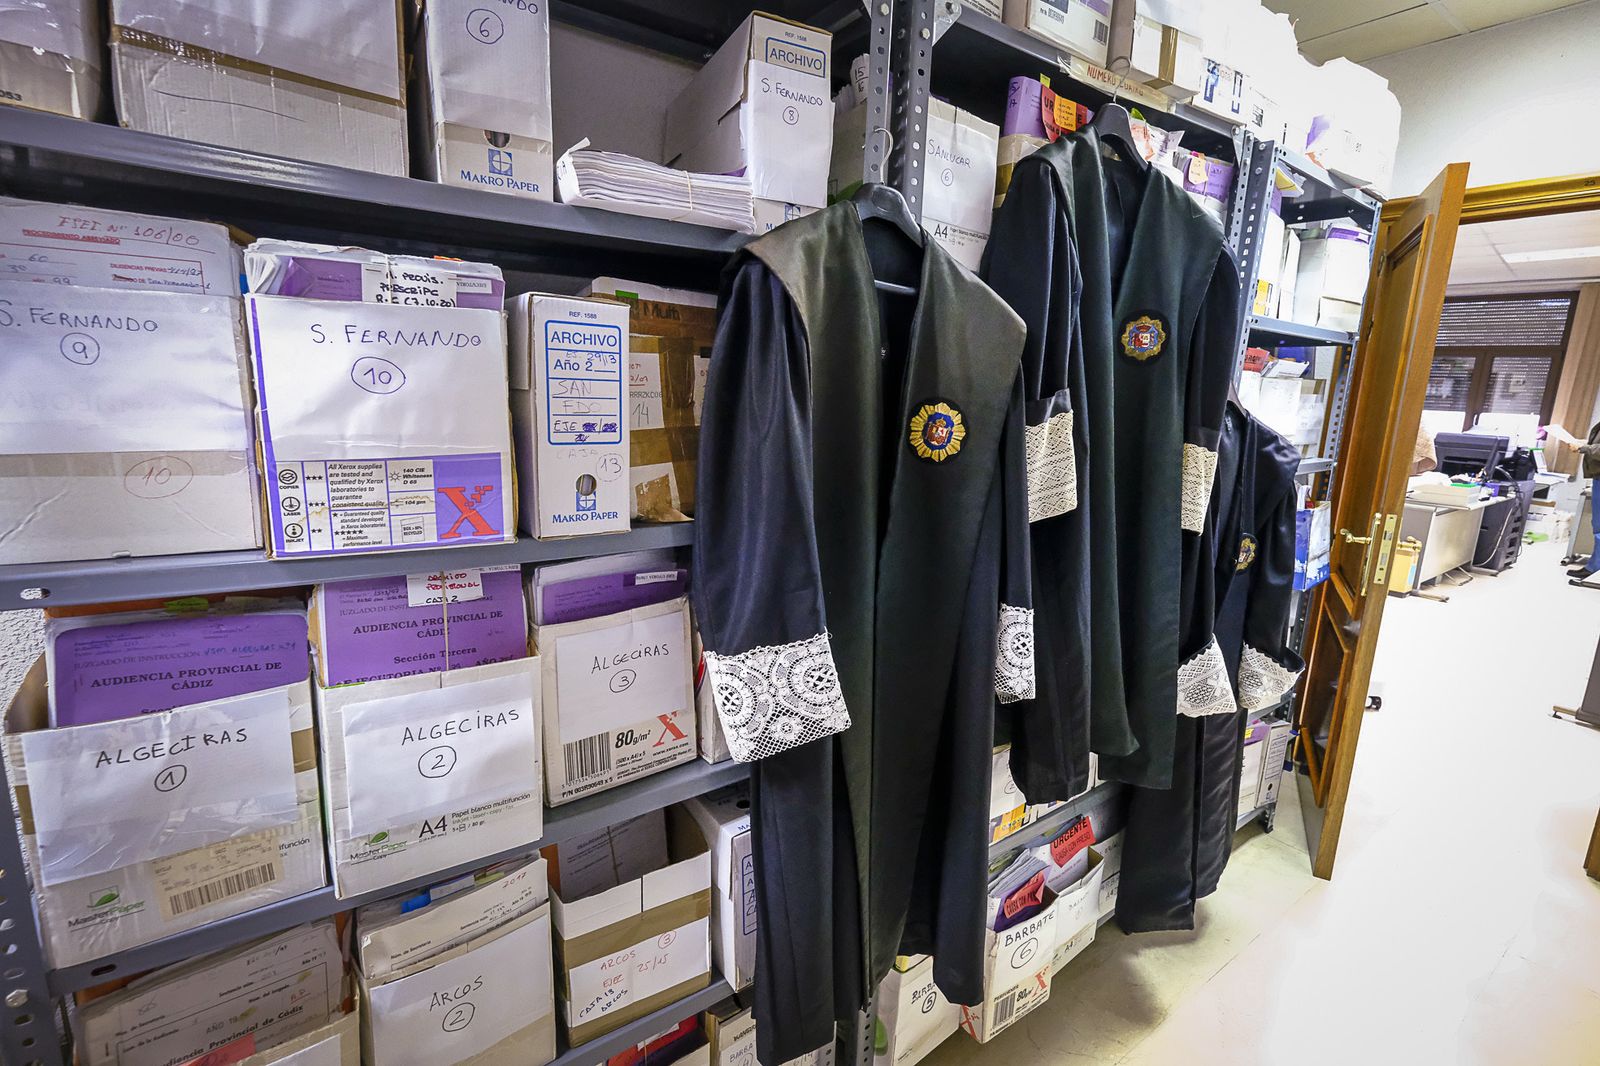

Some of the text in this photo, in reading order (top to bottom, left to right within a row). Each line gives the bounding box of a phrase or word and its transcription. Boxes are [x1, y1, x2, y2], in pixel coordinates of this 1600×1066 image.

[480, 17, 490, 37] 6
[769, 47, 823, 71] ARCHIVO
[761, 78, 823, 106] S. FERNANDO
[927, 139, 971, 169] SANLUCAR
[460, 170, 540, 193] MAKRO PAPER
[934, 223, 948, 239] A4
[30, 307, 159, 332] FERNANDO
[569, 311, 583, 319] REF.
[310, 323, 482, 348] S. FERNANDO
[550, 330, 618, 348] ARCHIVO
[72, 341, 88, 359] 9
[363, 367, 393, 385] 10
[554, 359, 581, 371] Año
[552, 380, 592, 398] SAN
[553, 420, 578, 433] EJE
[632, 402, 649, 428] 14
[142, 466, 172, 487] 10
[600, 458, 622, 475] 13
[552, 511, 619, 524] MAKRO PAPER
[353, 610, 504, 635] AUDIENCIA PROVINCIAL DE
[393, 651, 436, 665] Sección
[591, 643, 670, 675] ALGECIRAS
[91, 661, 282, 689] AUDIENCIA PROVINCIAL DE
[171, 678, 214, 692] CÁDIZ
[402, 708, 520, 746] ALGECIRAS
[95, 727, 249, 769] ALGECIRAS
[431, 754, 446, 771] 2
[562, 788, 574, 799] P/N
[419, 814, 447, 839] A4
[452, 809, 469, 819] Papel
[470, 803, 492, 814] blanco
[492, 793, 531, 809] multifunción
[1053, 819, 1088, 849] URGENTE
[1005, 910, 1056, 948] BARBATE
[600, 949, 637, 972] ARCOS
[429, 974, 484, 1012] ARCOS
[208, 1022, 259, 1050] Provincial
[262, 1016, 275, 1026] de
[277, 1003, 304, 1021] Cádiz
[449, 1009, 466, 1028] 2
